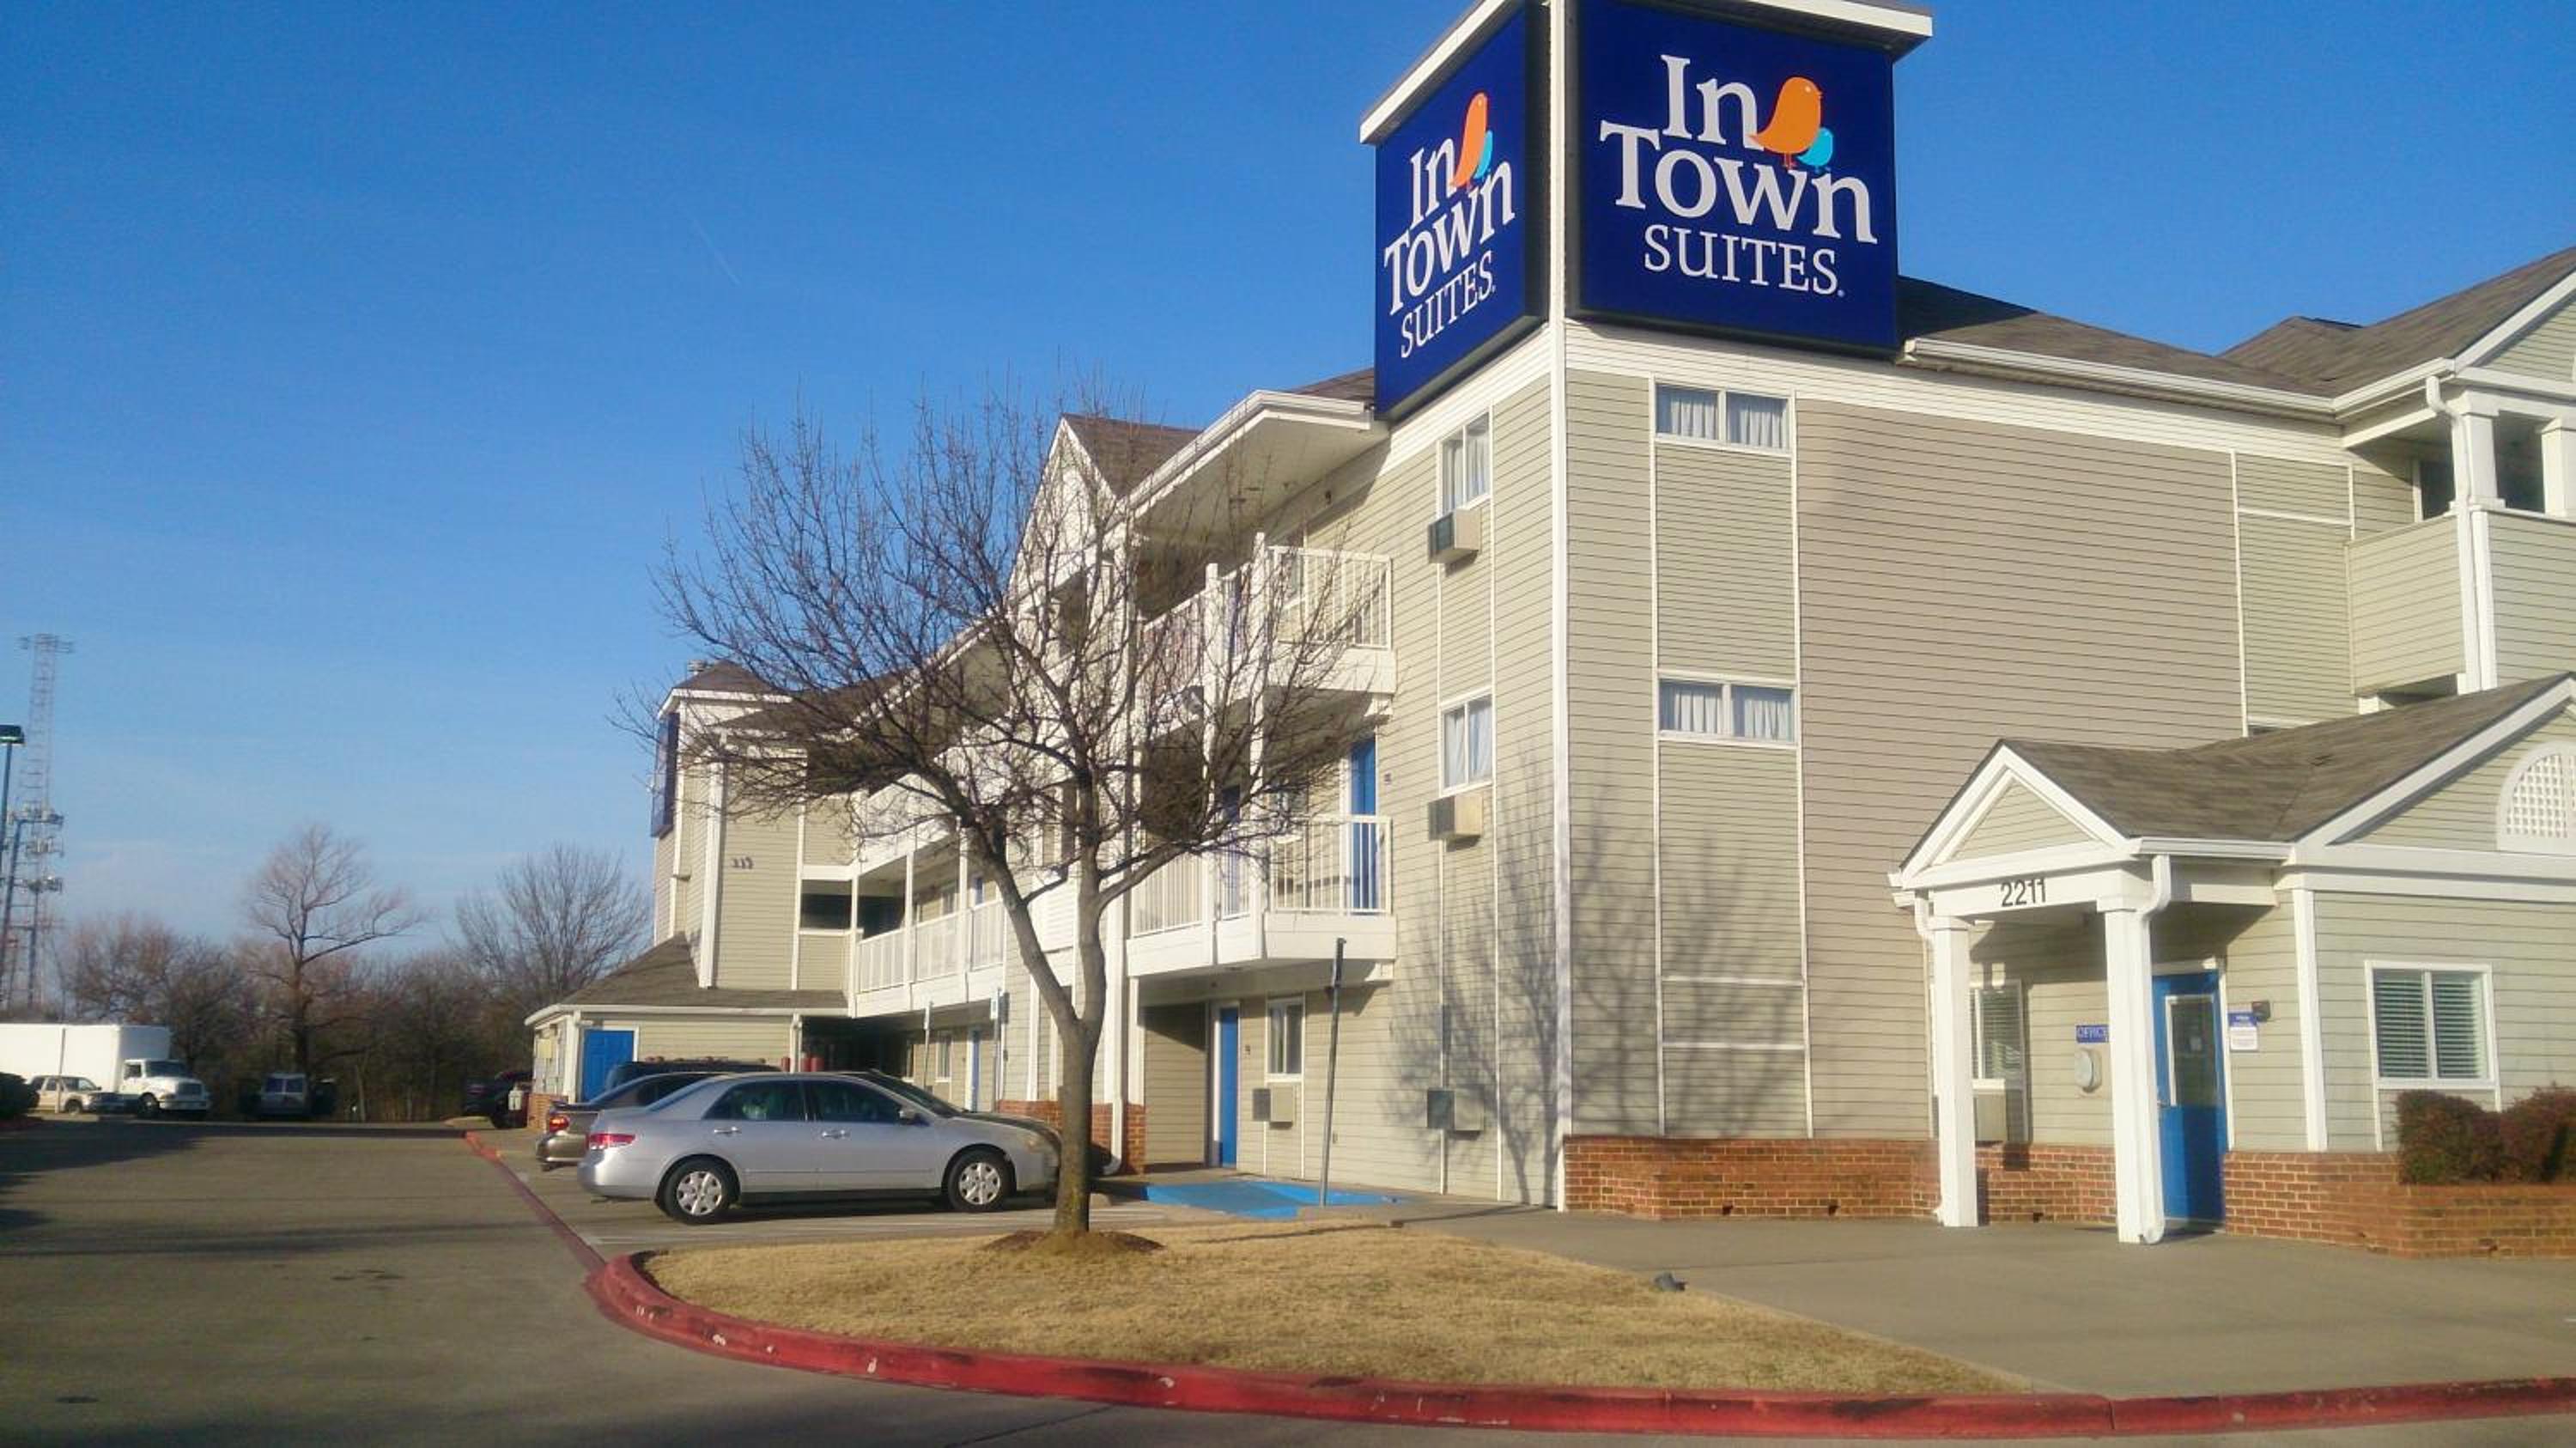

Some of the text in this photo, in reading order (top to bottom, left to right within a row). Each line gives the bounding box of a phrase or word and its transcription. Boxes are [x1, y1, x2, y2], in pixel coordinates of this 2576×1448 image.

[1661, 54, 1765, 151] In
[1410, 137, 1458, 230] In
[1600, 119, 1879, 244] Town
[1383, 161, 1516, 316] Town
[1644, 224, 1838, 295] SUITES
[1400, 250, 1493, 358] SUITES
[2000, 878, 2046, 907] 2211
